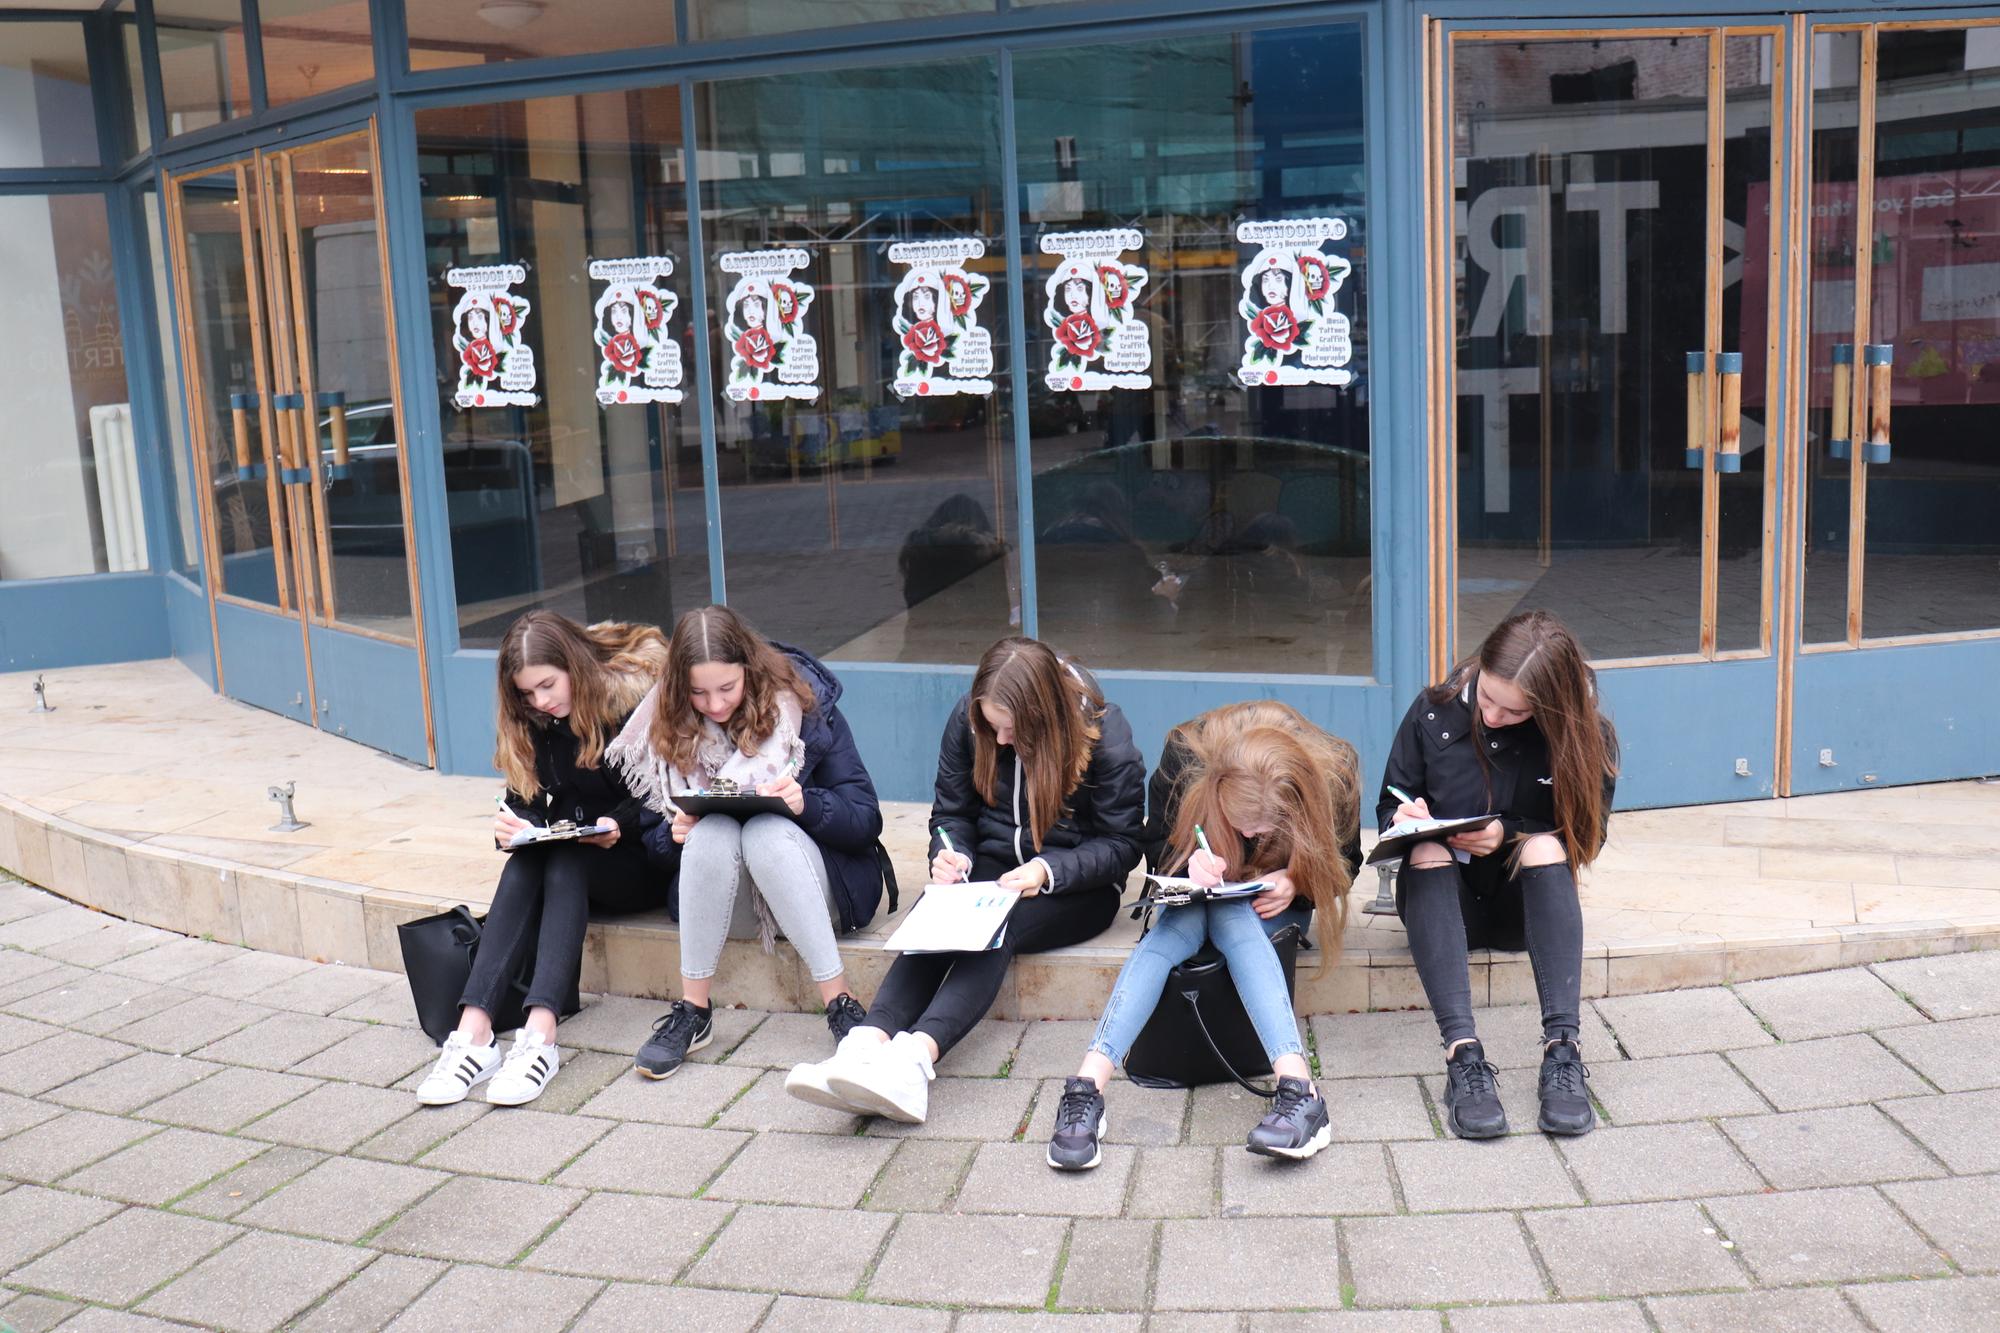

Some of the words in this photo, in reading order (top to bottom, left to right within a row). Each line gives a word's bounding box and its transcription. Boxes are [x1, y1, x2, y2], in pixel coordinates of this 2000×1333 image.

[1241, 224, 1317, 240] ARTNOON
[1045, 235, 1114, 251] ARTNOON
[1285, 239, 1319, 247] December
[893, 245, 958, 260] ARTNOON
[724, 255, 785, 269] ARTNOON
